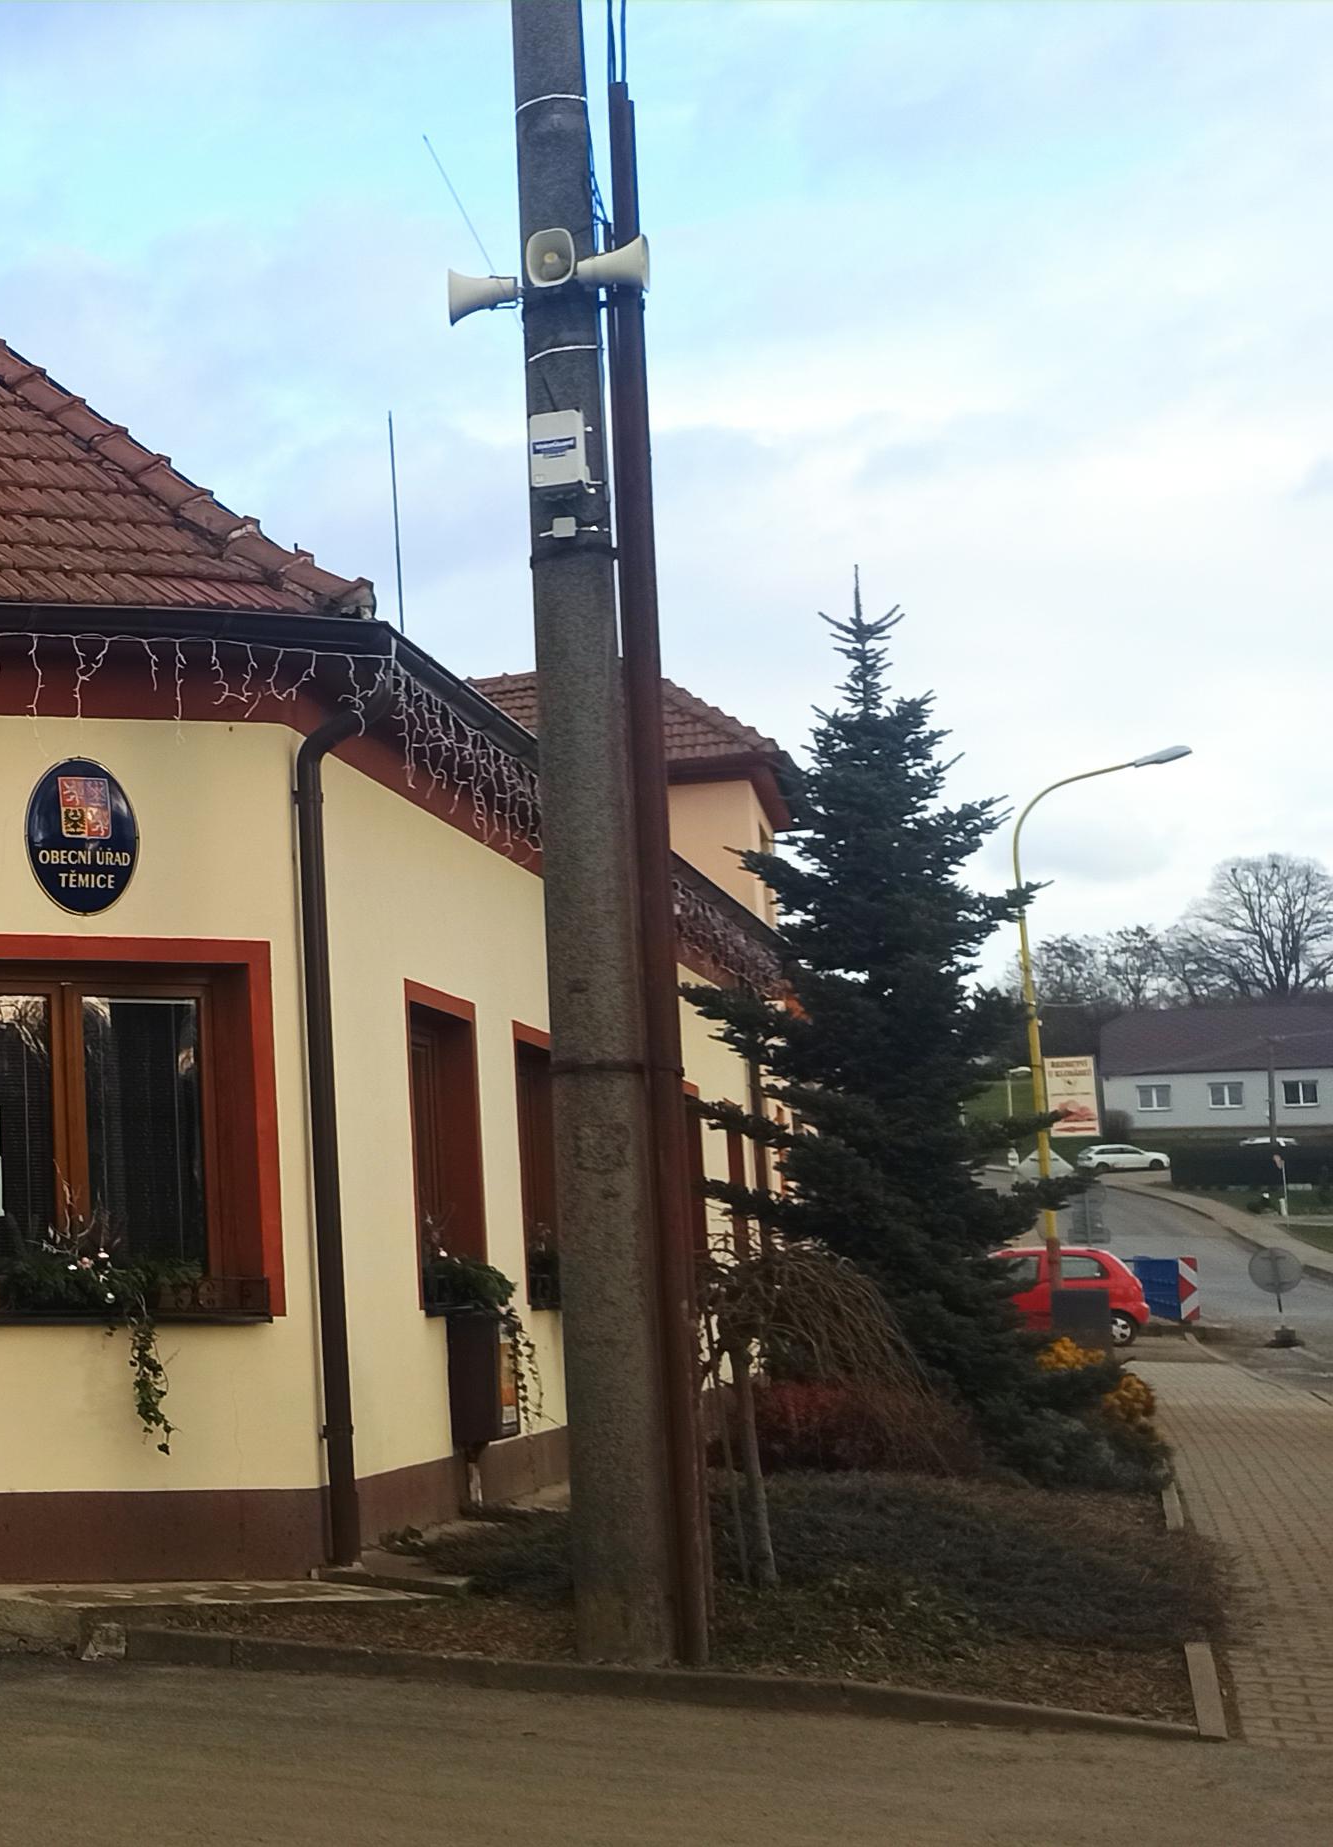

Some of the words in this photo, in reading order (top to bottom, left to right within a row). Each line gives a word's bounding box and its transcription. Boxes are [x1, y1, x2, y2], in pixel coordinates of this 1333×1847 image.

[39, 845, 91, 865] OBECNÍ
[96, 847, 131, 866] ÚŘAD
[59, 869, 115, 889] TĚMICE
